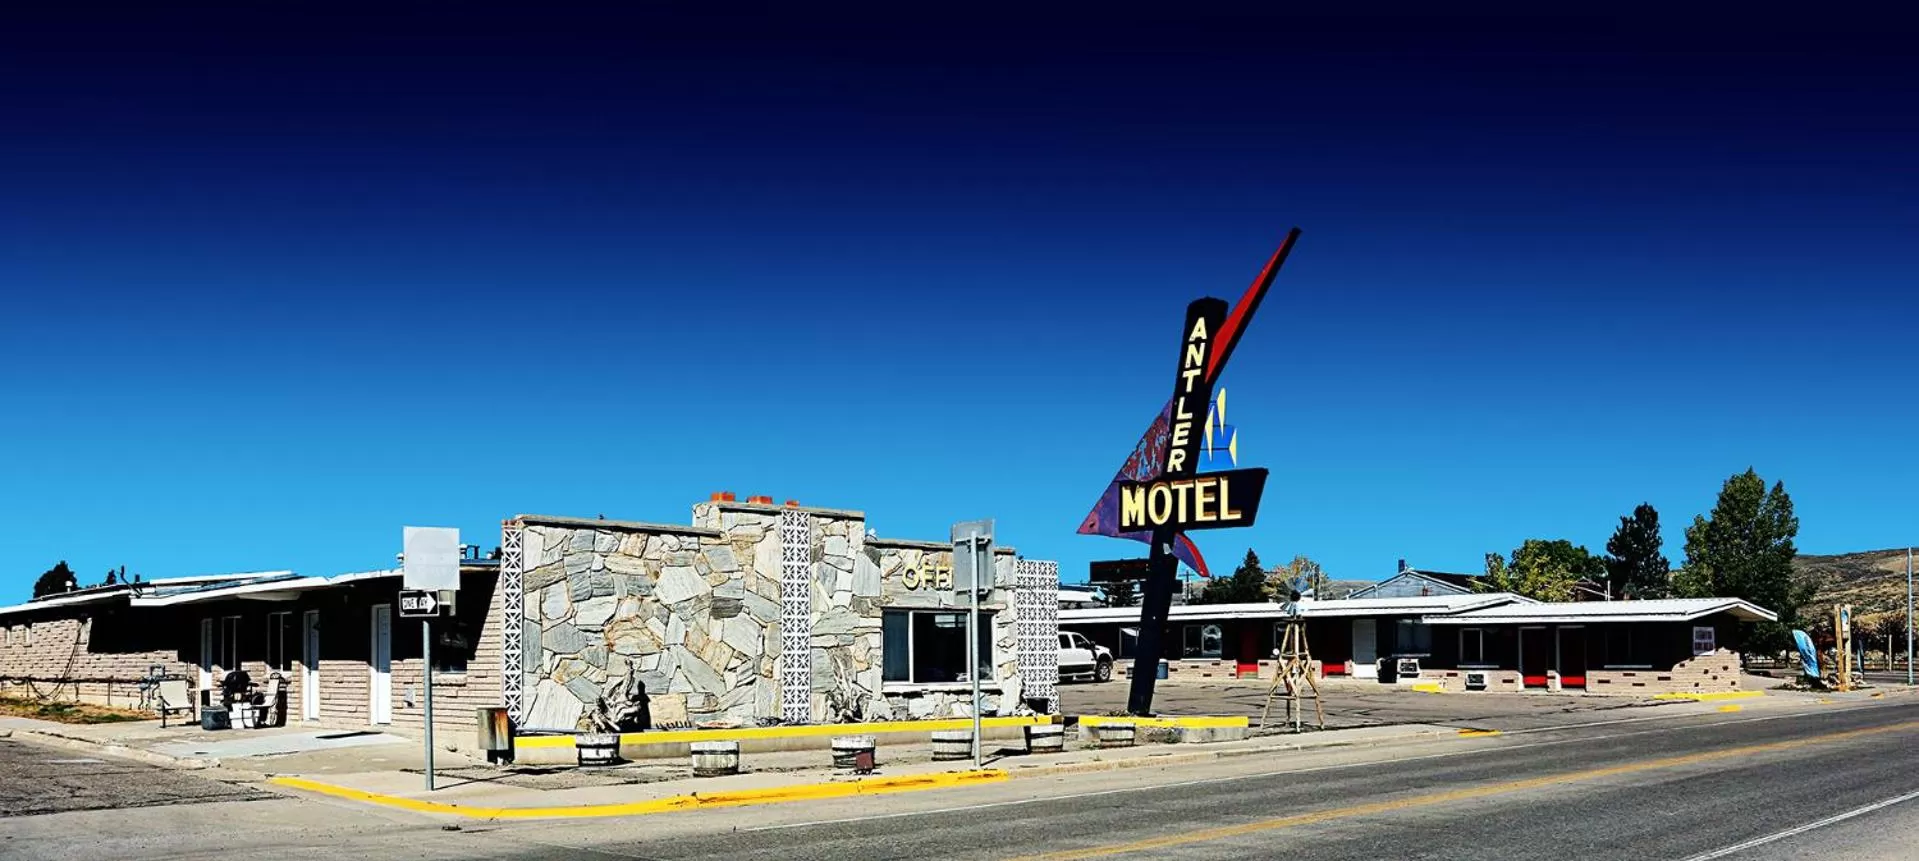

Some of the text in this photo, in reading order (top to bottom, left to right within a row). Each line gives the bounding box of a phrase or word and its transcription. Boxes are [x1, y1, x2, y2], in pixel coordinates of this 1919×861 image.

[1166, 316, 1207, 473] ANTLER
[1121, 476, 1242, 527] MOTEL
[902, 565, 953, 589] OFFI
